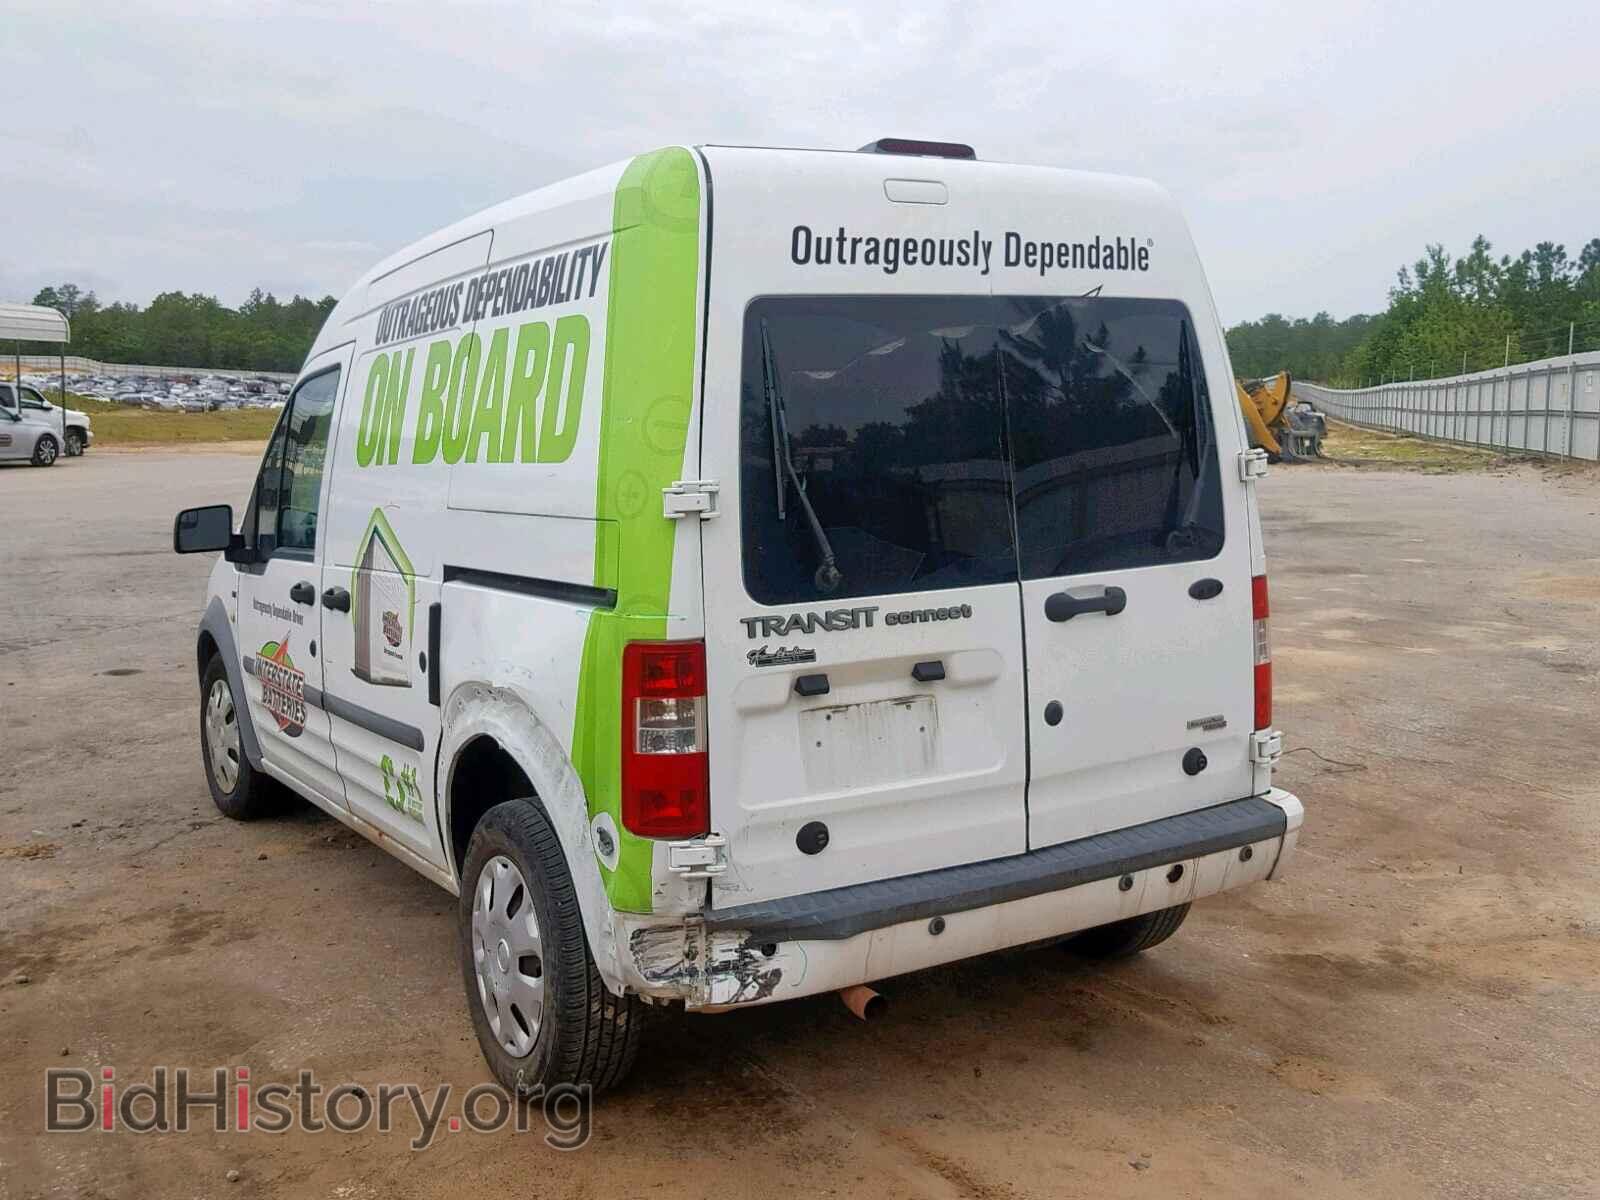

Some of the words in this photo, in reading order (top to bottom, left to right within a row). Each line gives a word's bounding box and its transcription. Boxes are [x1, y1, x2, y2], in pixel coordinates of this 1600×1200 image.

[791, 225, 993, 276] Outrageously
[375, 281, 465, 346] OUTRAGEOUS
[462, 241, 609, 324] DEPENDABILITY
[356, 346, 416, 468] ON
[411, 314, 591, 465] BOARD
[740, 606, 879, 639] TRANSIT
[885, 604, 973, 626] connect
[255, 655, 304, 697] INTERSTATE
[263, 685, 305, 725] BATTERIES
